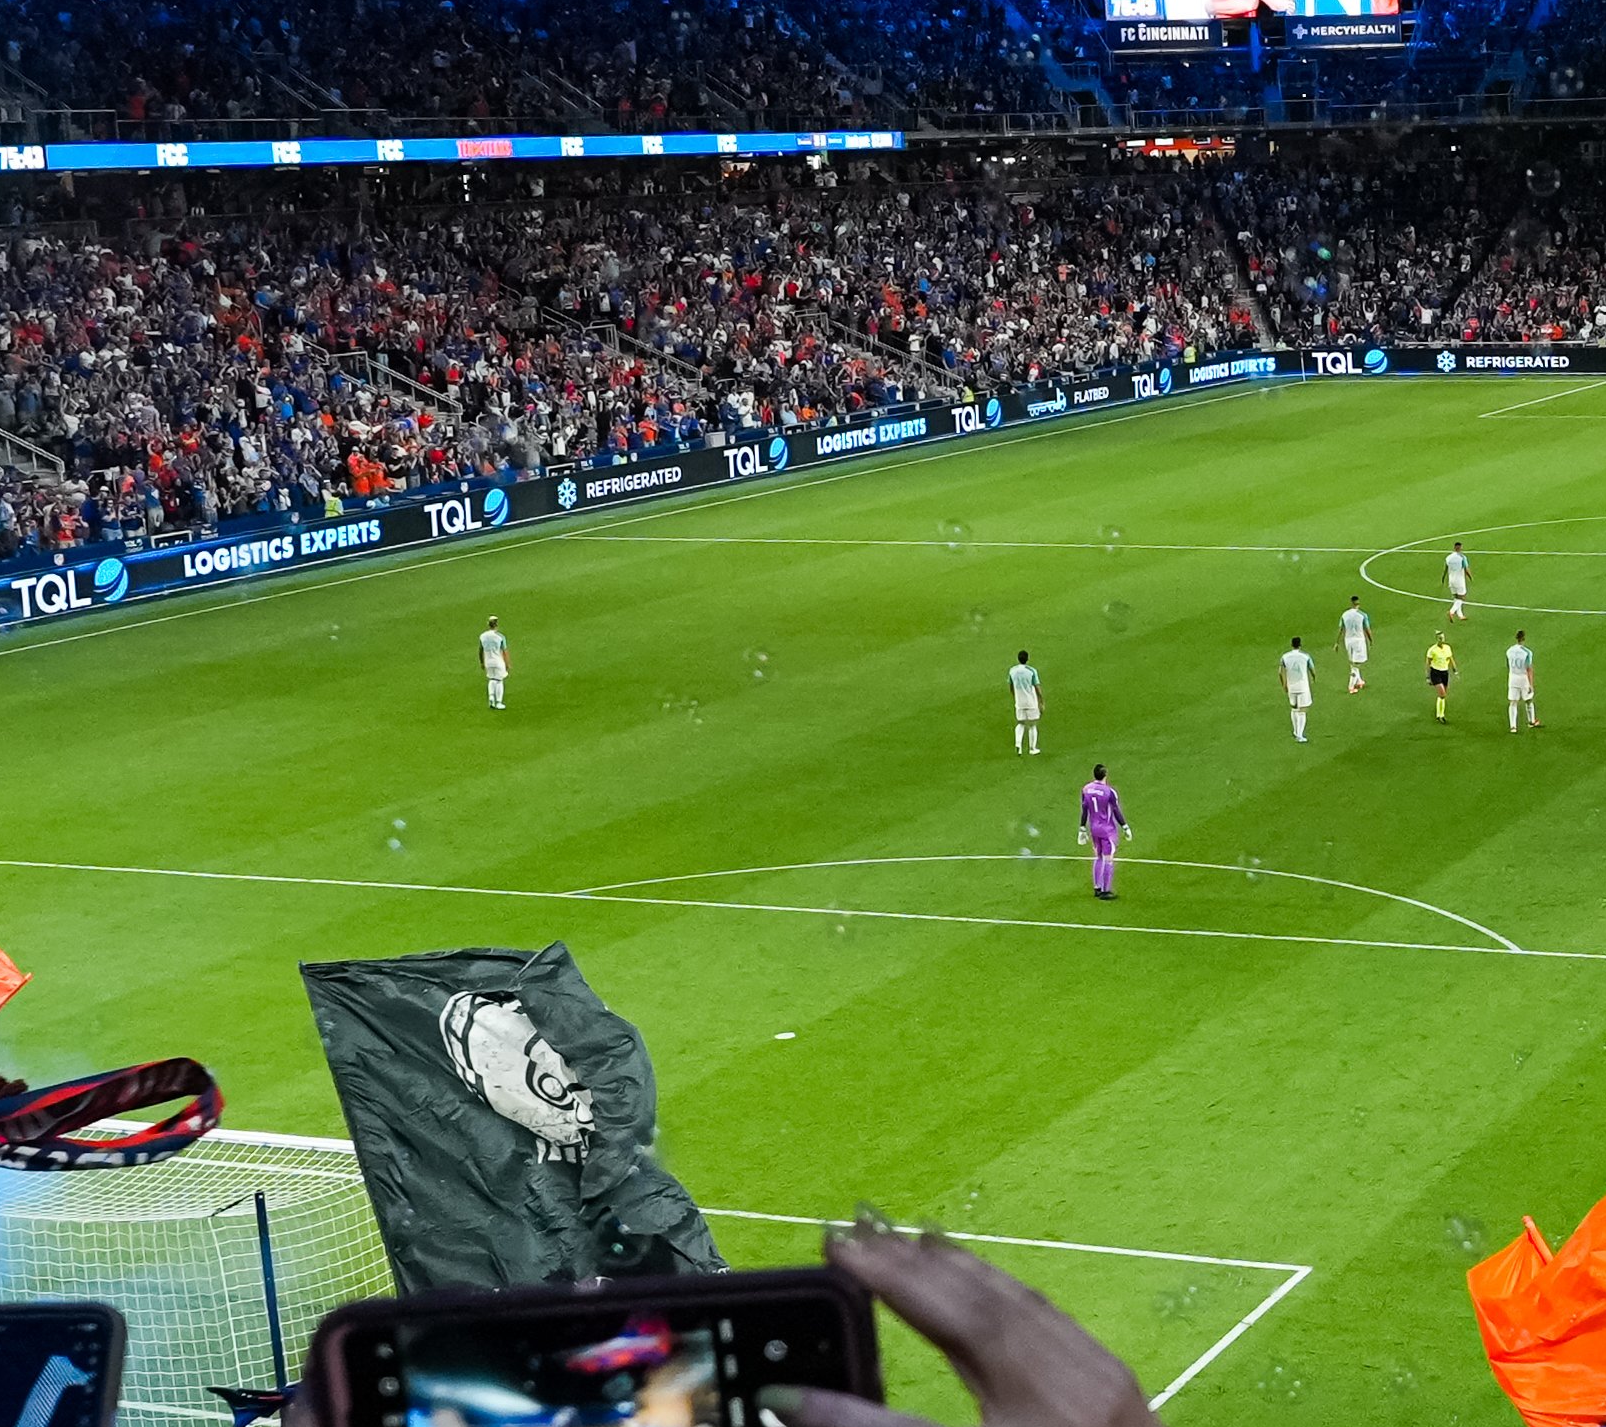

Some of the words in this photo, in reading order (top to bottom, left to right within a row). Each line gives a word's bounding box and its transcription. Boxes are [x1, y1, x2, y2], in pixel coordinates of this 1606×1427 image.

[1120, 27, 1136, 43] FC
[1138, 25, 1209, 42] CINCINNATI
[1311, 24, 1396, 36] MERCYHEALTH
[156, 143, 188, 166] FCC
[272, 142, 302, 164] FCC
[1189, 362, 1229, 384] LOGISTICS
[1312, 352, 1362, 374] TQL
[1466, 355, 1570, 369] REFRIGERATED
[1074, 386, 1110, 405] FLATBED
[1131, 374, 1159, 399] TQL
[951, 404, 986, 434] TQL
[816, 428, 877, 456] LOGISTICS
[879, 418, 927, 443] EXPERTS
[724, 447, 769, 478] TQL
[585, 466, 682, 499] REFRIGERATED
[424, 500, 482, 537] TQL
[183, 536, 294, 578] LOGISTICS
[300, 519, 381, 555] EXPERTS
[11, 570, 92, 618] TQL
[1092, 797, 1099, 812] 1
